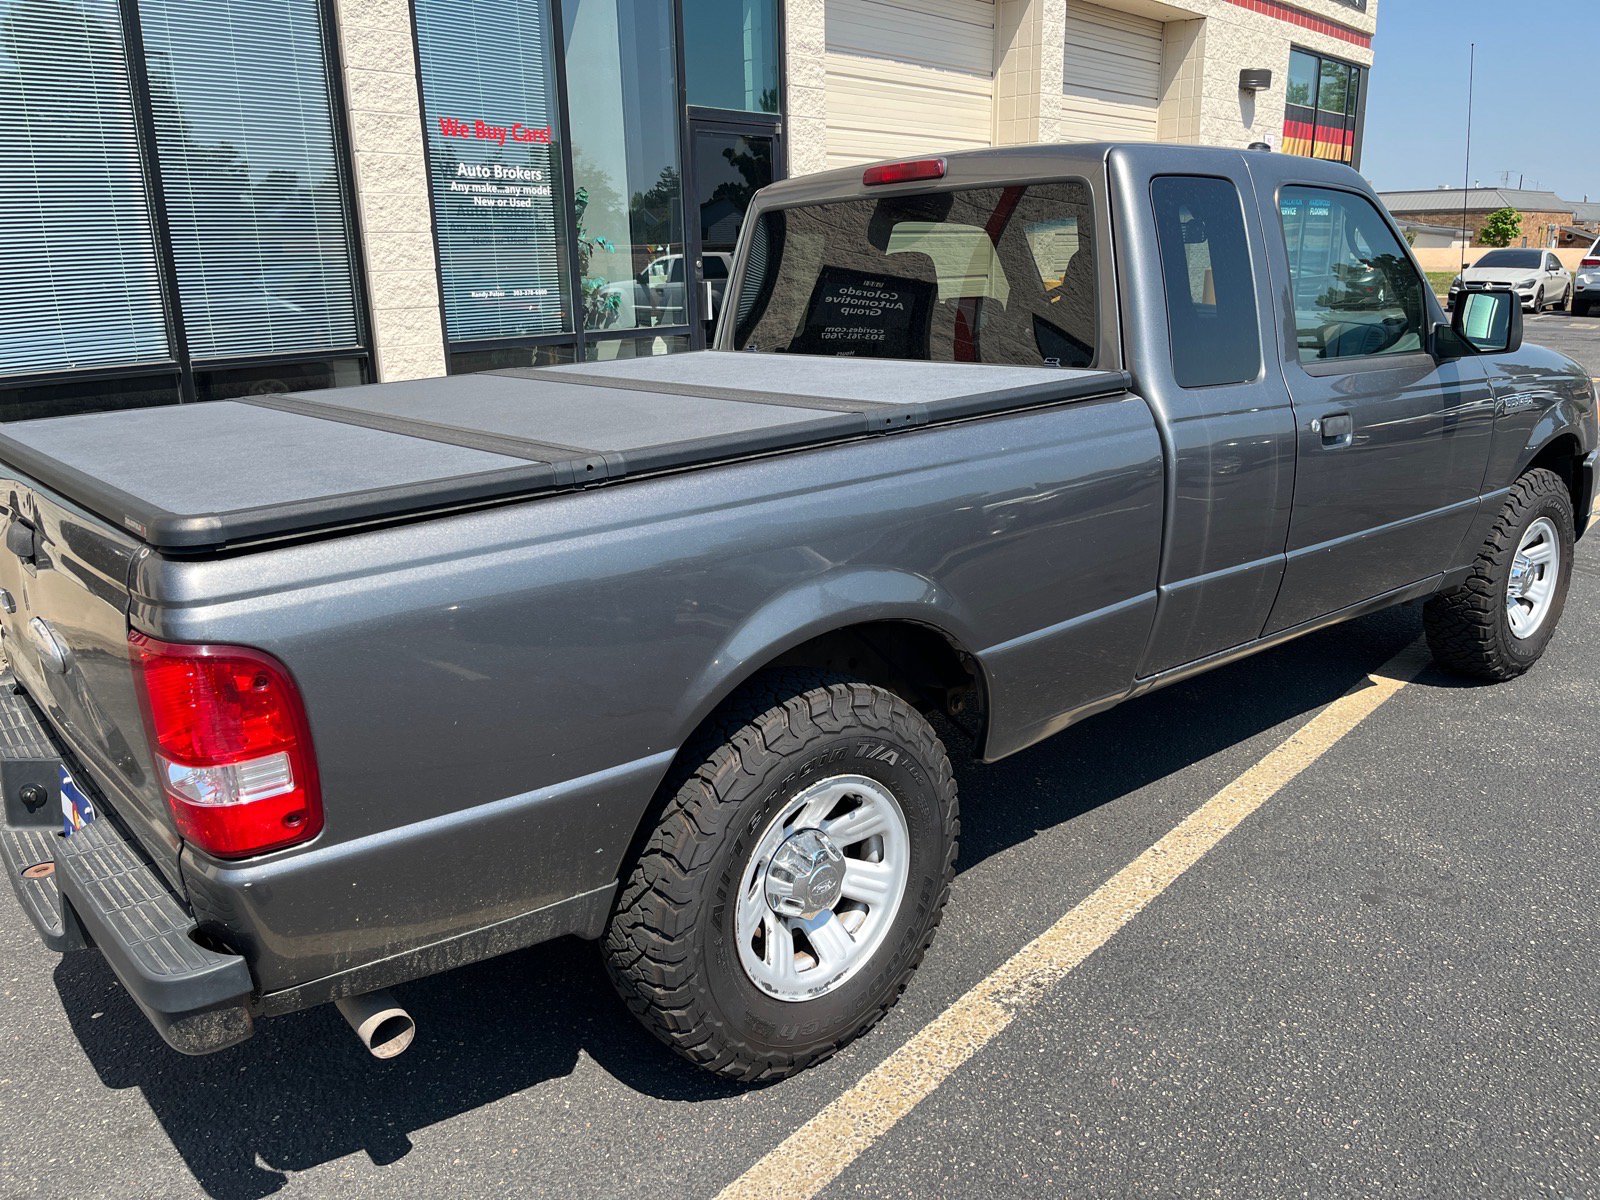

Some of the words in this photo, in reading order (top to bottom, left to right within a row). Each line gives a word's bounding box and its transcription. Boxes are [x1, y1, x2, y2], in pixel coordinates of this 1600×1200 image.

[439, 117, 469, 138] We
[475, 119, 507, 147] Buy
[512, 123, 552, 144] Cars!
[457, 162, 490, 178] Auto
[494, 164, 542, 180] Brokers
[451, 181, 471, 194] Any
[523, 185, 551, 196] model
[473, 196, 495, 207] New
[497, 199, 507, 207] or
[510, 197, 532, 208] Used
[854, 741, 900, 767] T/A
